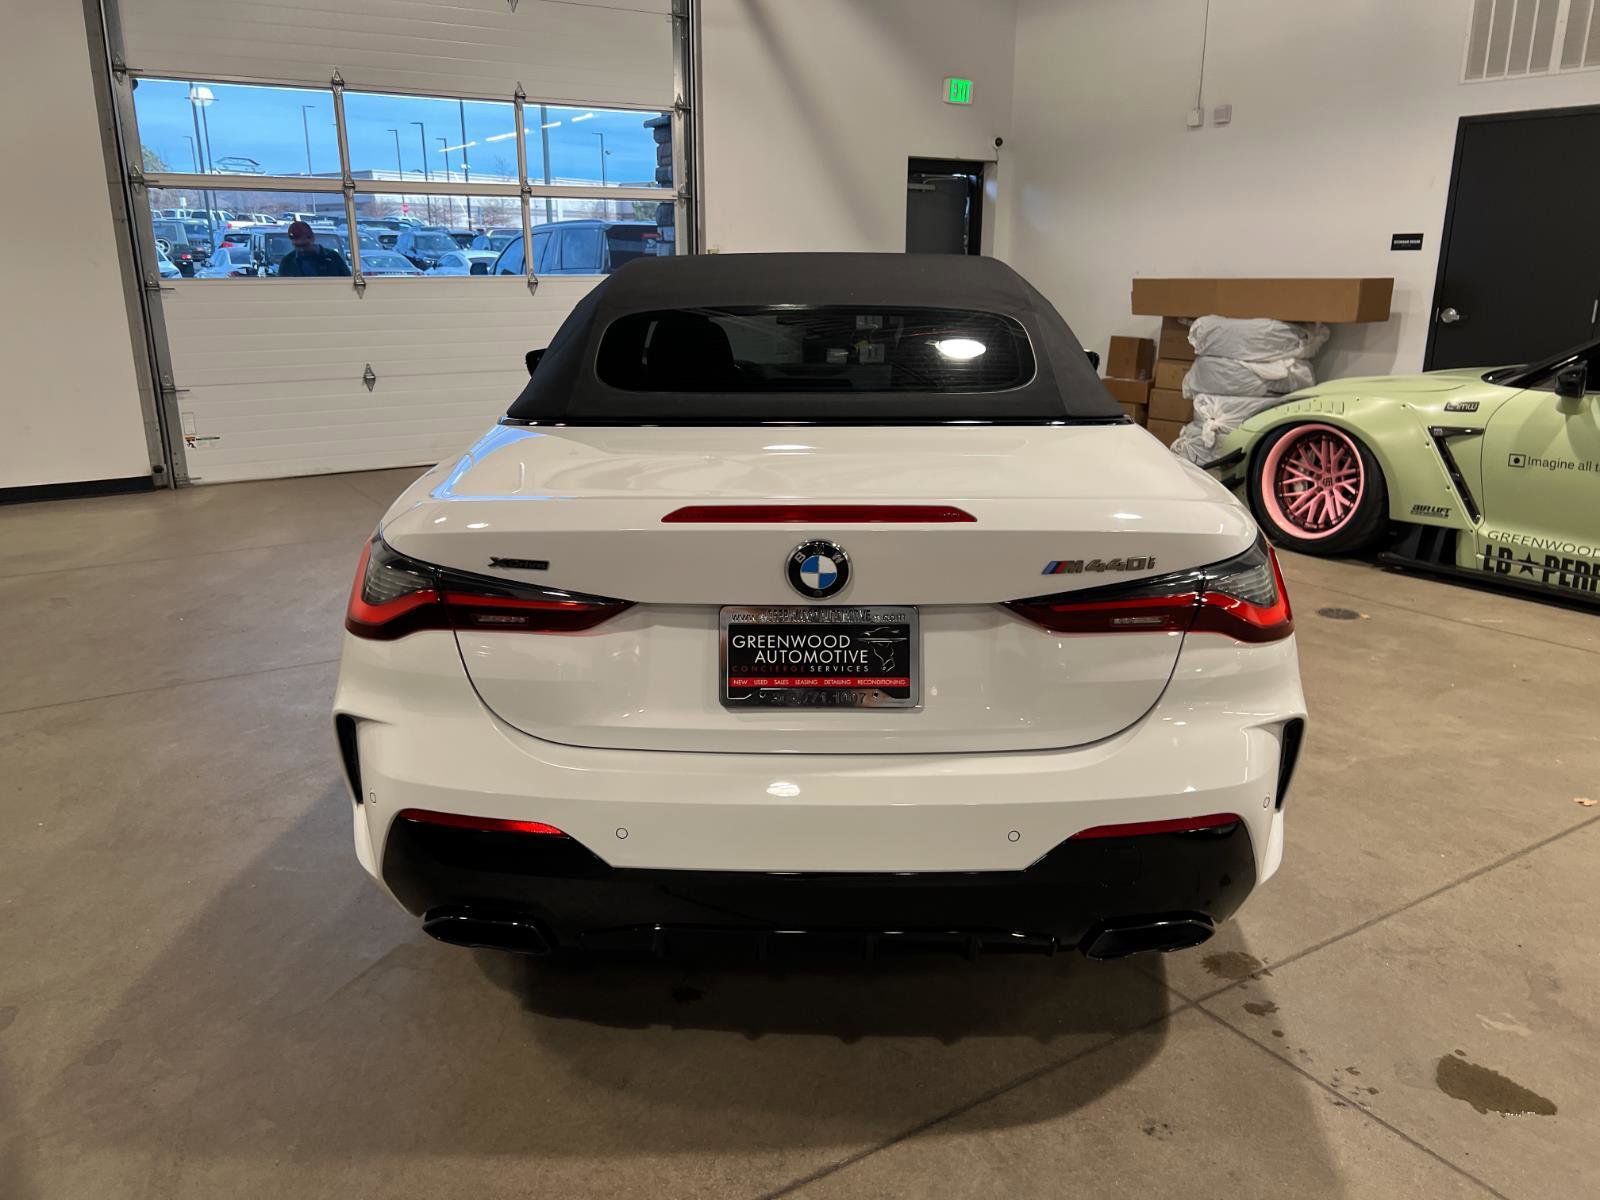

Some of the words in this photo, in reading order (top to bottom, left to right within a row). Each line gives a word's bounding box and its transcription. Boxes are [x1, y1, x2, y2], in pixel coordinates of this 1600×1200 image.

[950, 79, 971, 103] EXIT
[1528, 456, 1575, 471] Imagine
[1578, 460, 1592, 472] all
[1483, 544, 1513, 575] LB
[732, 634, 850, 649] GREENWOOD
[754, 649, 869, 664] AUTOMOTIVE
[810, 664, 870, 673] SERVICES
